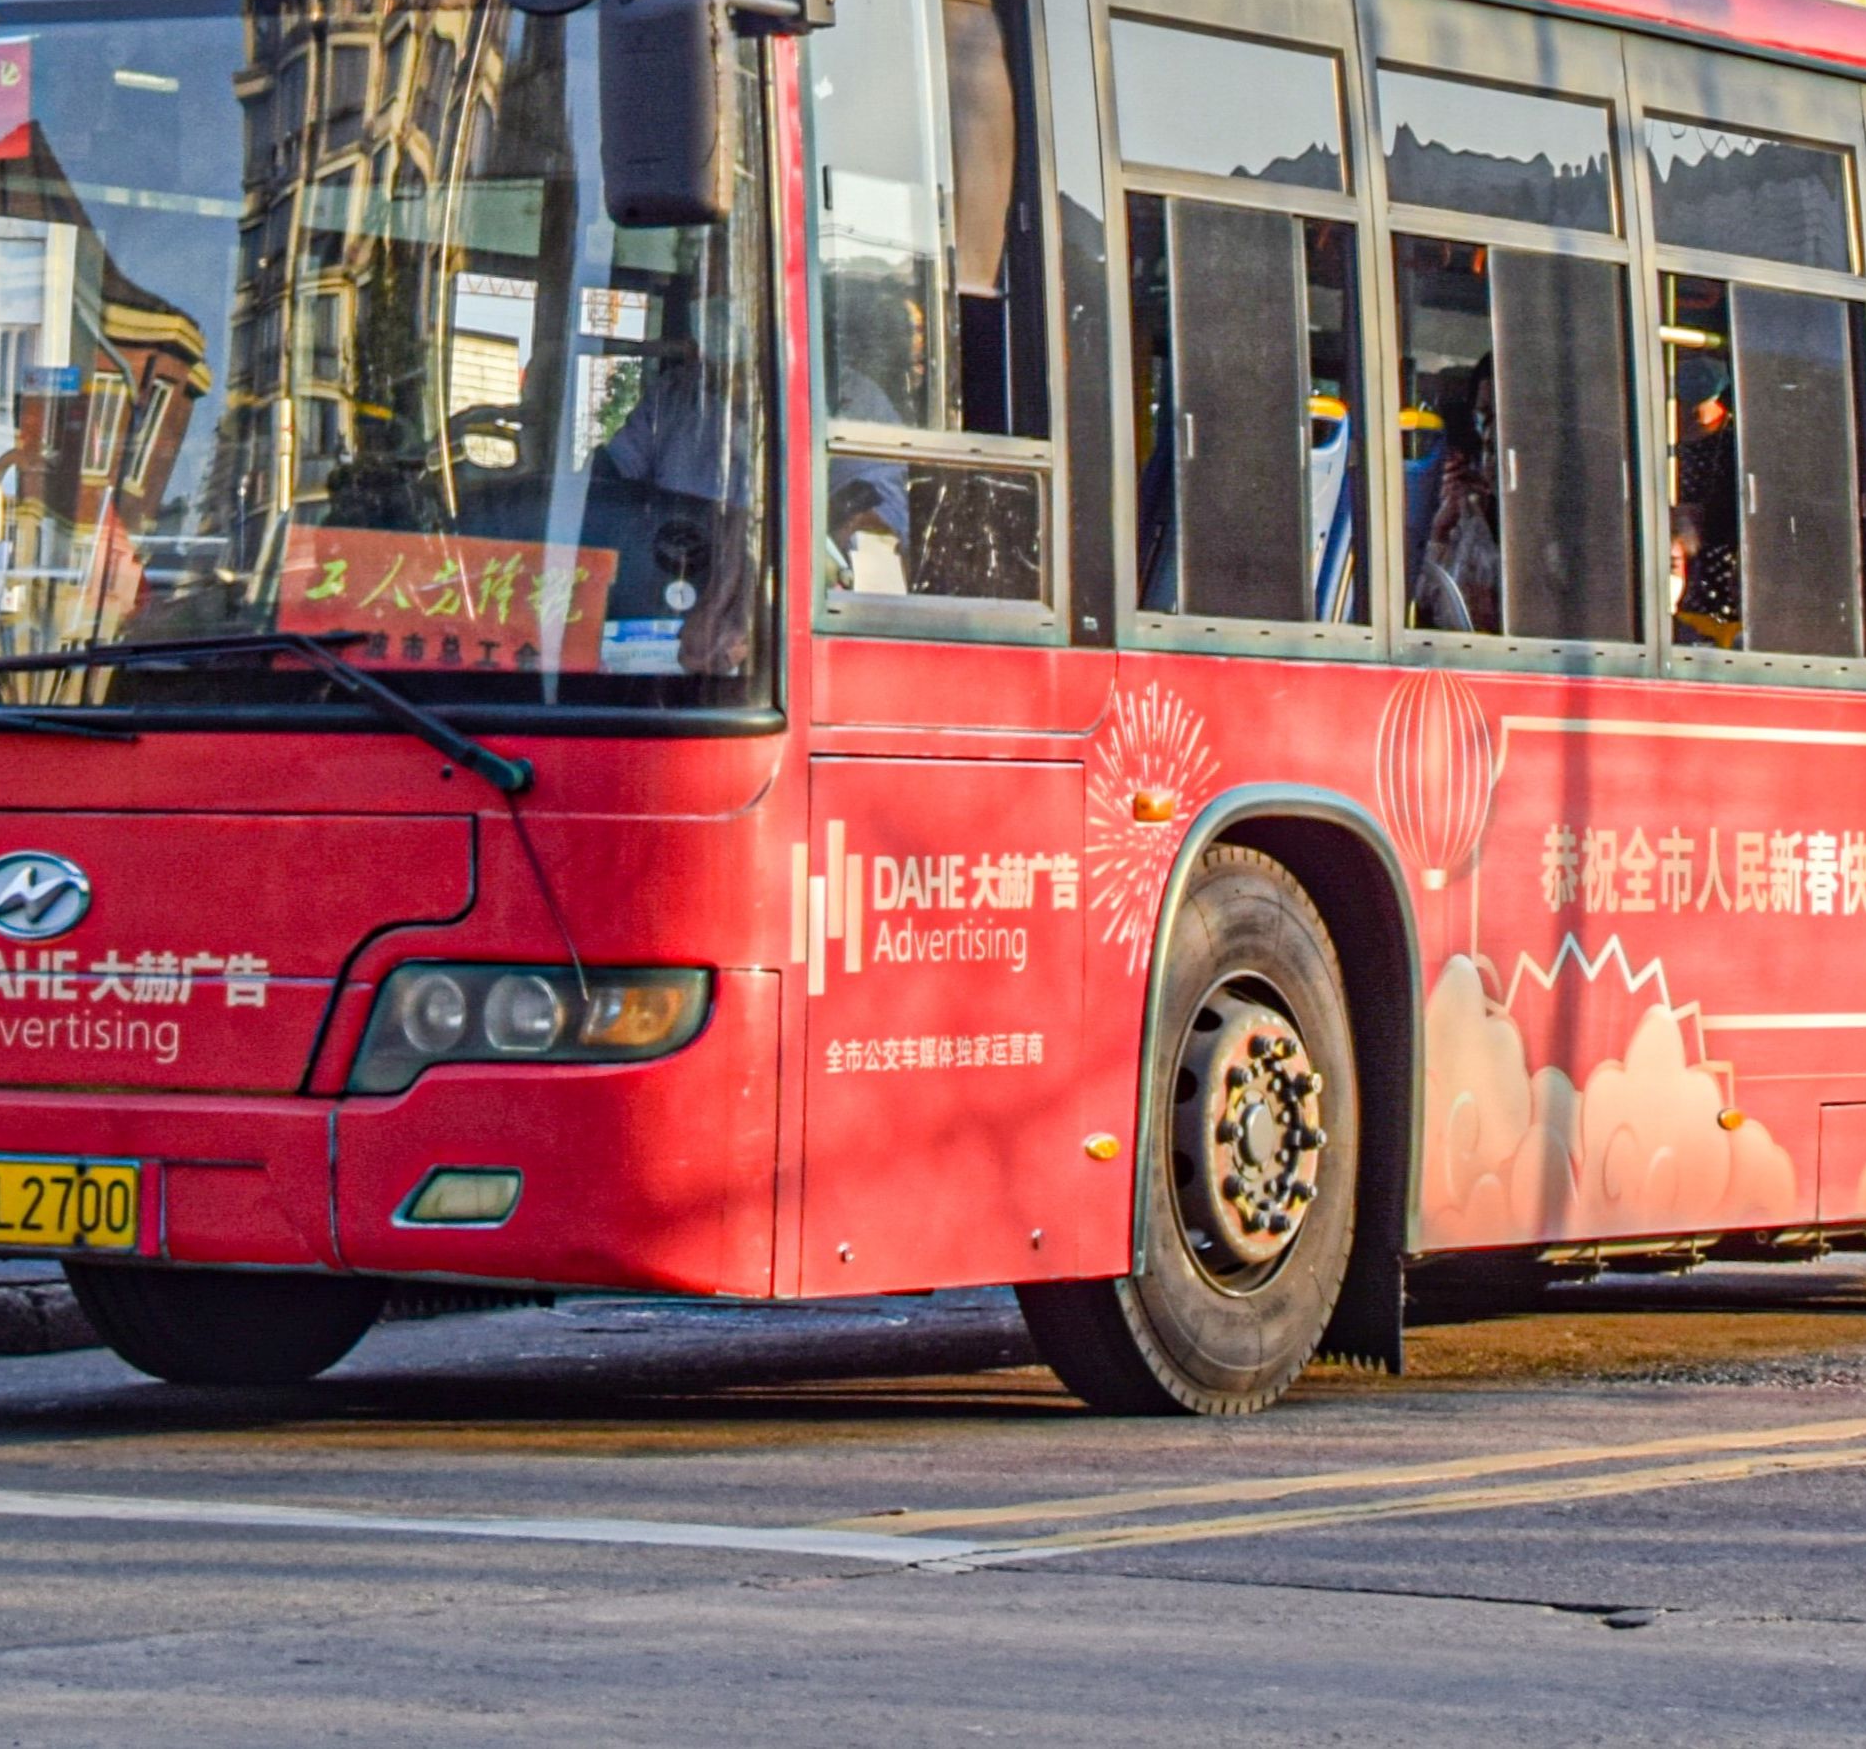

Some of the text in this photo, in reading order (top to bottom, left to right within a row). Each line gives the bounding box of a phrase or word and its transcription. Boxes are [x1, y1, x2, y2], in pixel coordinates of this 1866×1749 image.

[363, 631, 547, 672] 波市总工会
[873, 852, 1079, 910] DAHE 大赫广告
[873, 918, 1028, 972] Advertising
[91, 951, 269, 1008] 大赫广告
[825, 1032, 1043, 1074] 全市公交车媒体独家运营商
